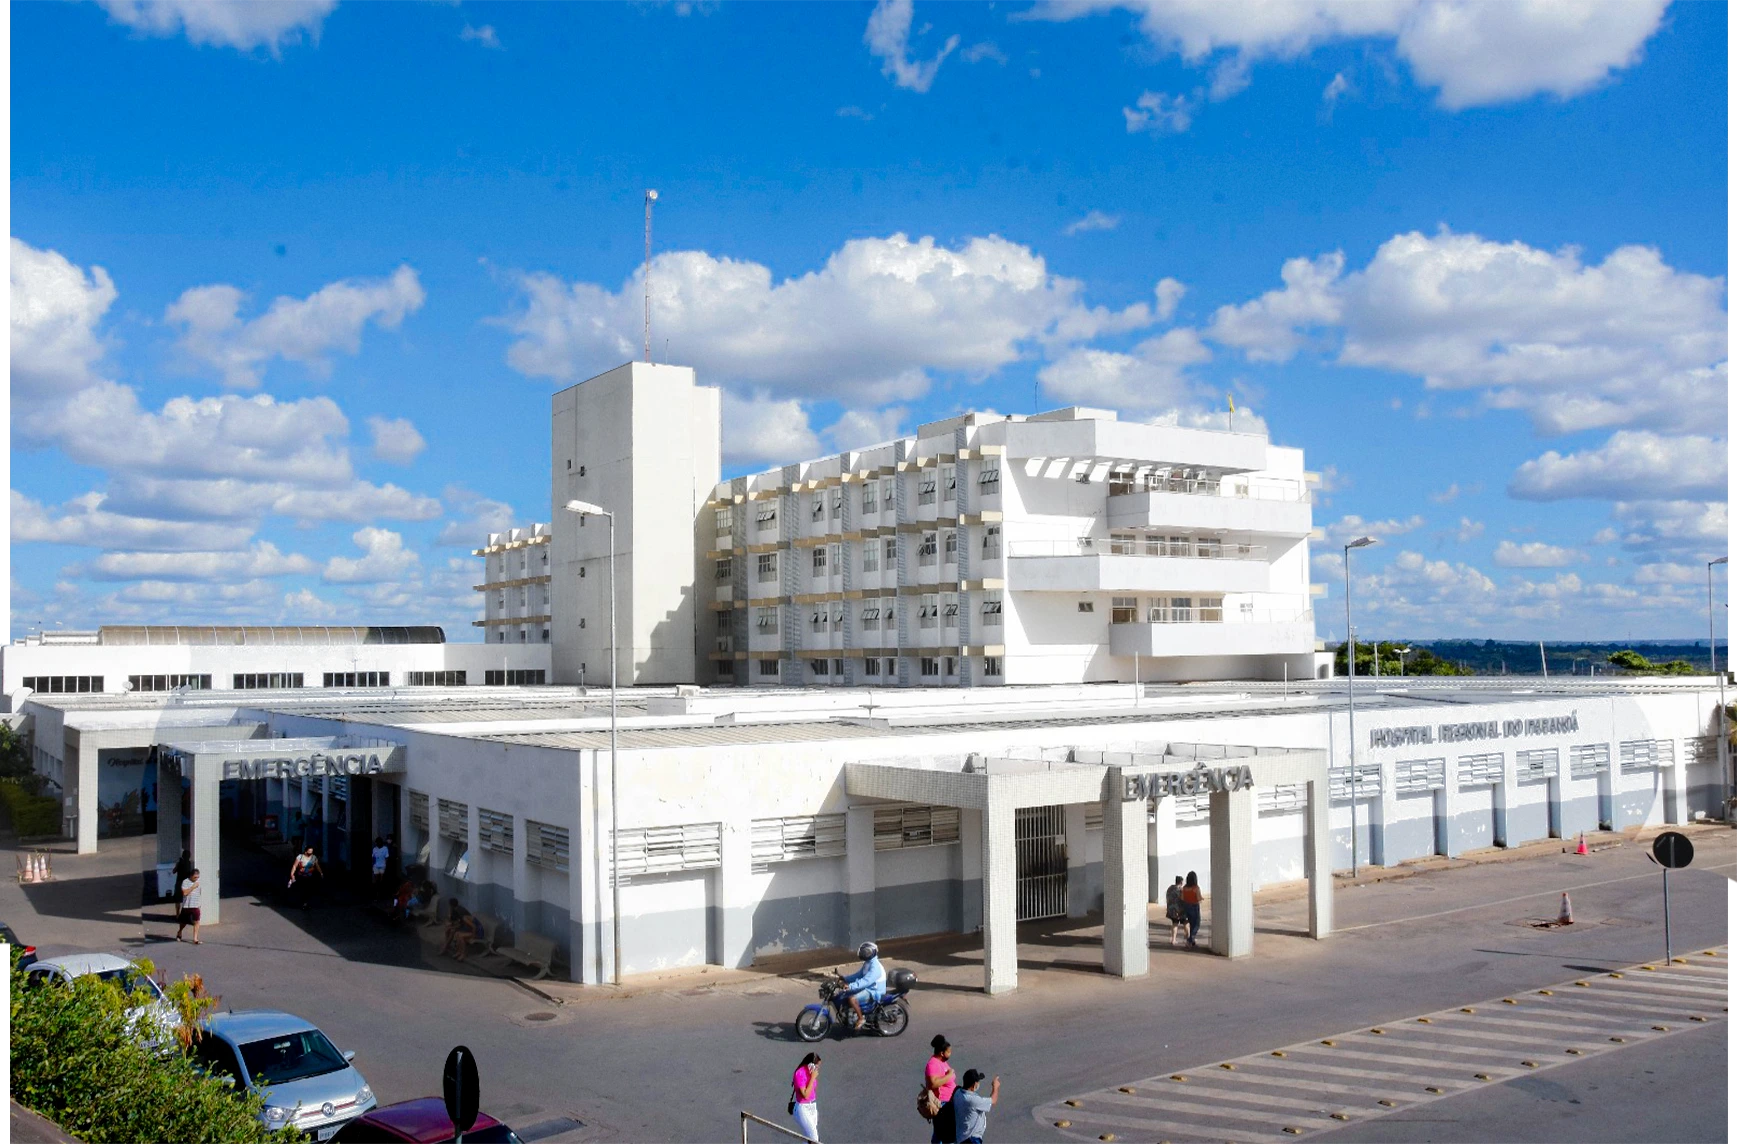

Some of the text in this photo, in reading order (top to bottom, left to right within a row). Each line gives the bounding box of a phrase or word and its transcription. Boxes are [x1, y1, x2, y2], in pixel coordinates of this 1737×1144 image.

[1370, 710, 1579, 749] HOSPITAL REGIONAL DO PARANOÁ
[223, 751, 383, 779] EMERGÊNCIA
